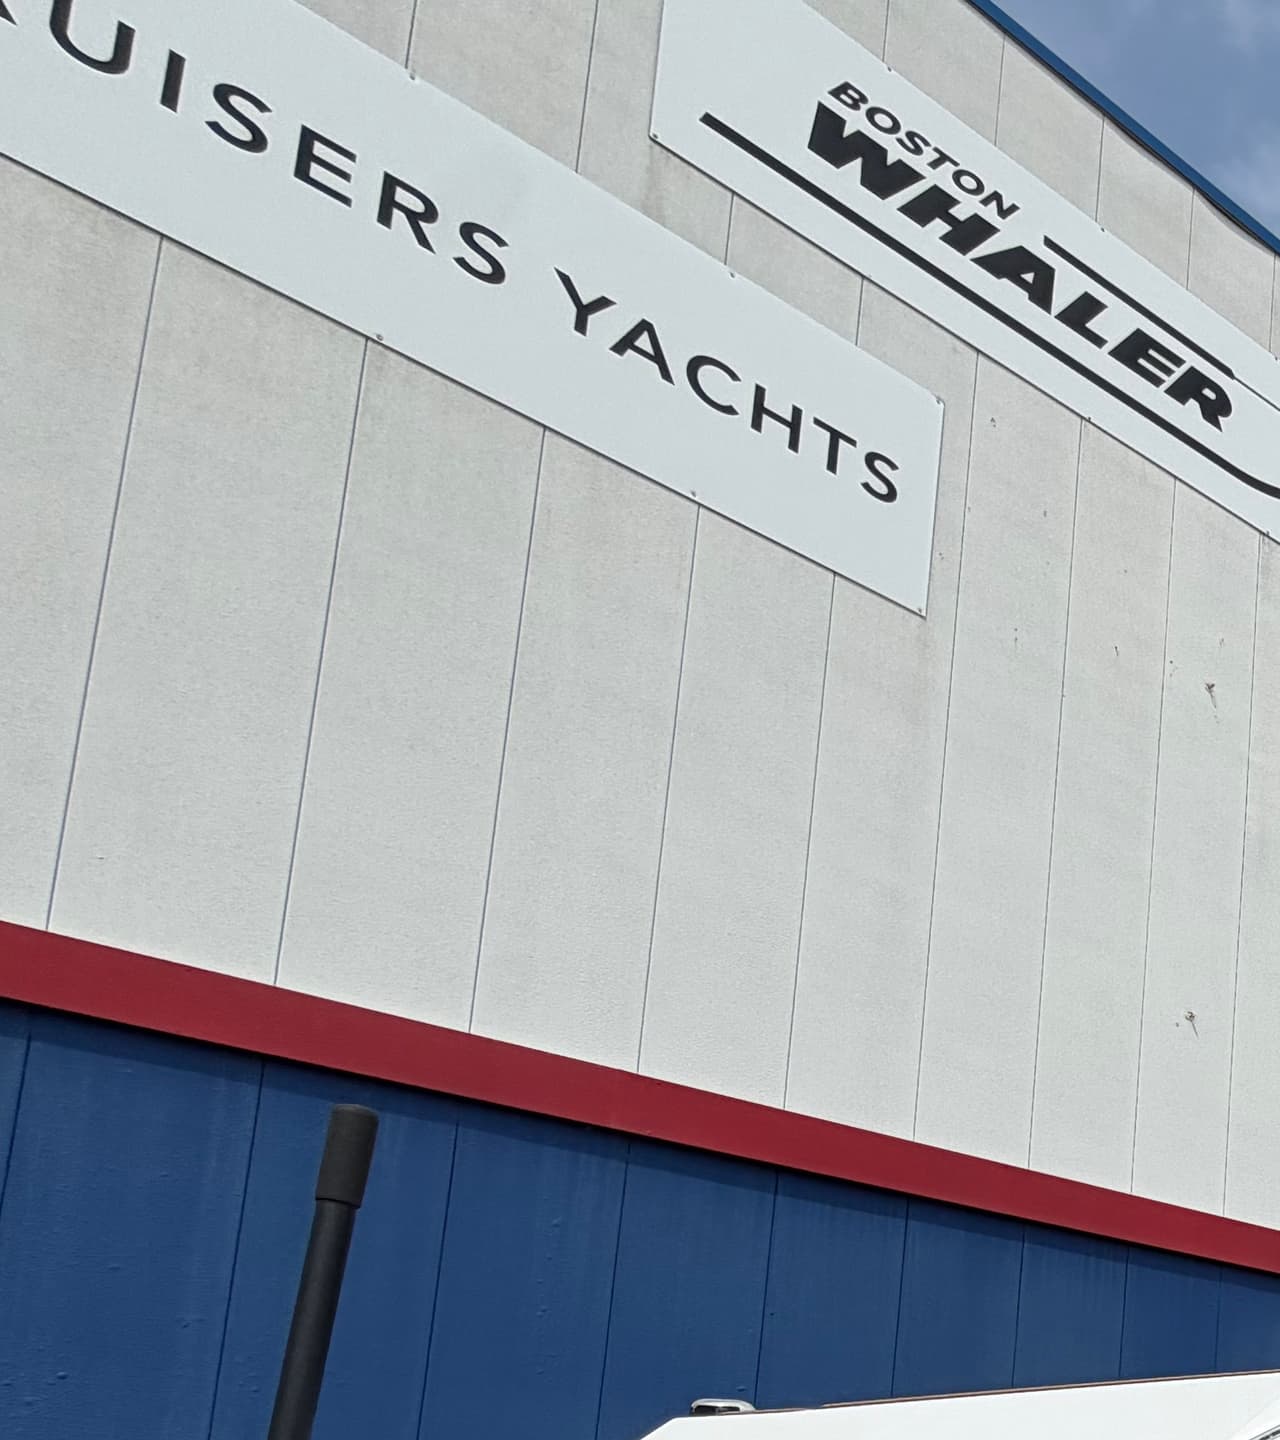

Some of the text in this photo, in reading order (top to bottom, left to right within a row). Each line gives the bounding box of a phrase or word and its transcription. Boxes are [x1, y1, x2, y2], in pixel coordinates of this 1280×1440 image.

[0, 0, 900, 504] UISERS YACHTS
[807, 101, 1233, 433] WHALER
[828, 81, 1020, 220] BOSTON
